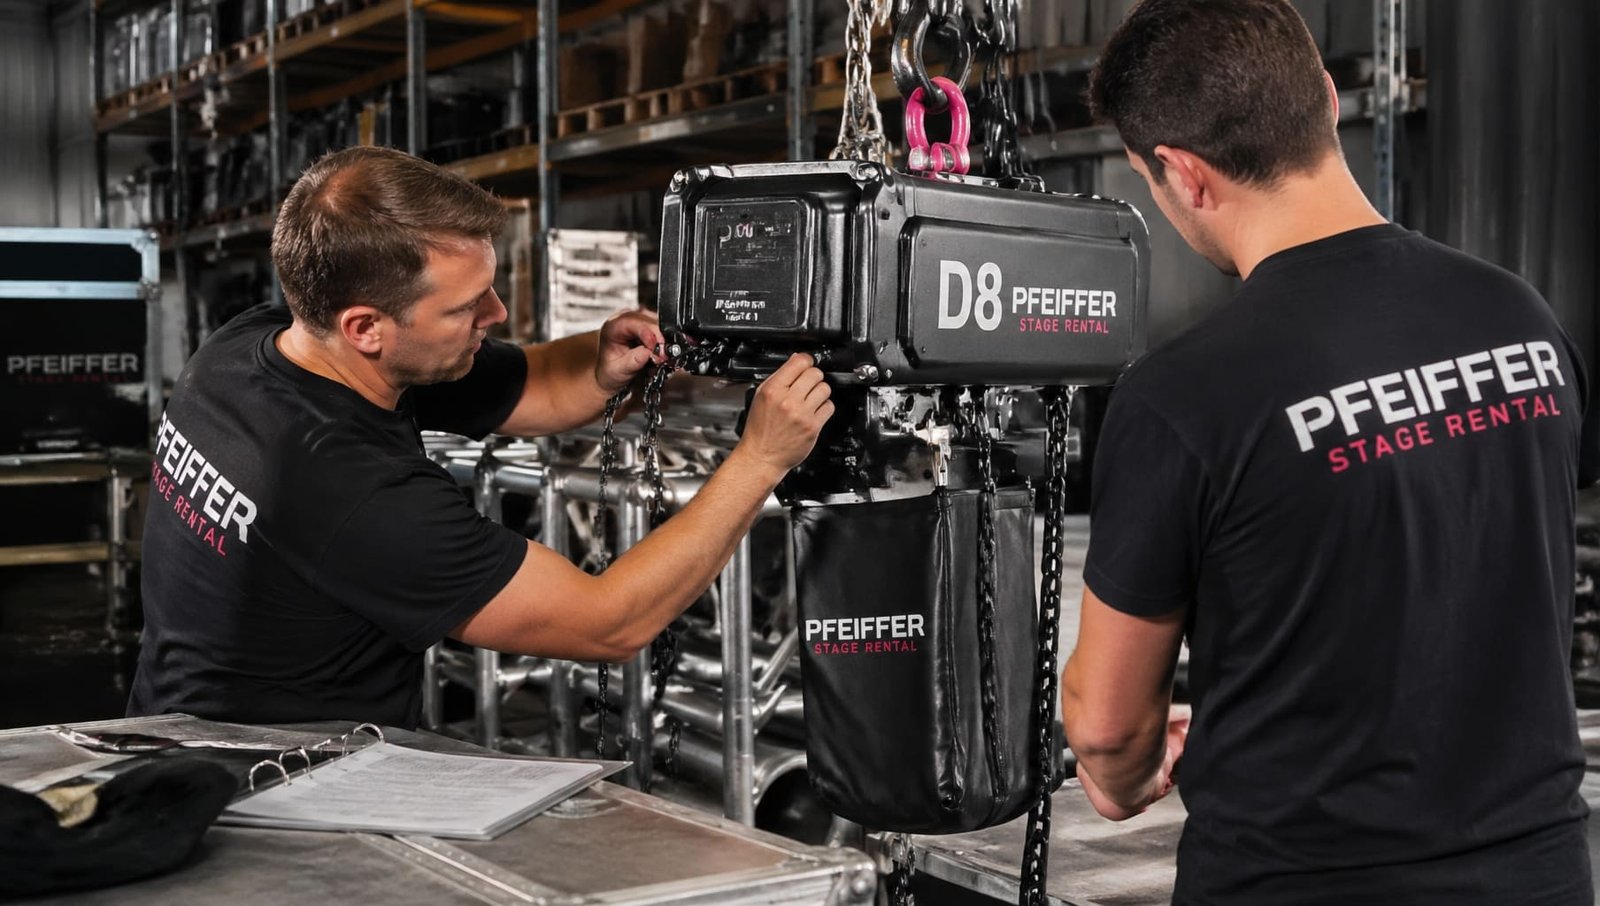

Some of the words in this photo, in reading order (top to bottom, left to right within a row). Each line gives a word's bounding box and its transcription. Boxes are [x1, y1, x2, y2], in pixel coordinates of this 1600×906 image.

[937, 259, 1003, 331] D8
[1011, 286, 1117, 317] PFEIFFER
[1019, 318, 1059, 333] STAGE
[1065, 319, 1109, 334] RENTAL
[7, 353, 138, 374] PFEIFFER
[1285, 341, 1565, 452] PFEIFFER
[1328, 421, 1434, 473] STAGE
[1444, 394, 1561, 438] RENTAL
[174, 495, 226, 556] RENTAL
[805, 614, 925, 641] PFEIFFER
[814, 642, 859, 655] STAGE
[865, 640, 917, 653] RENTAL
